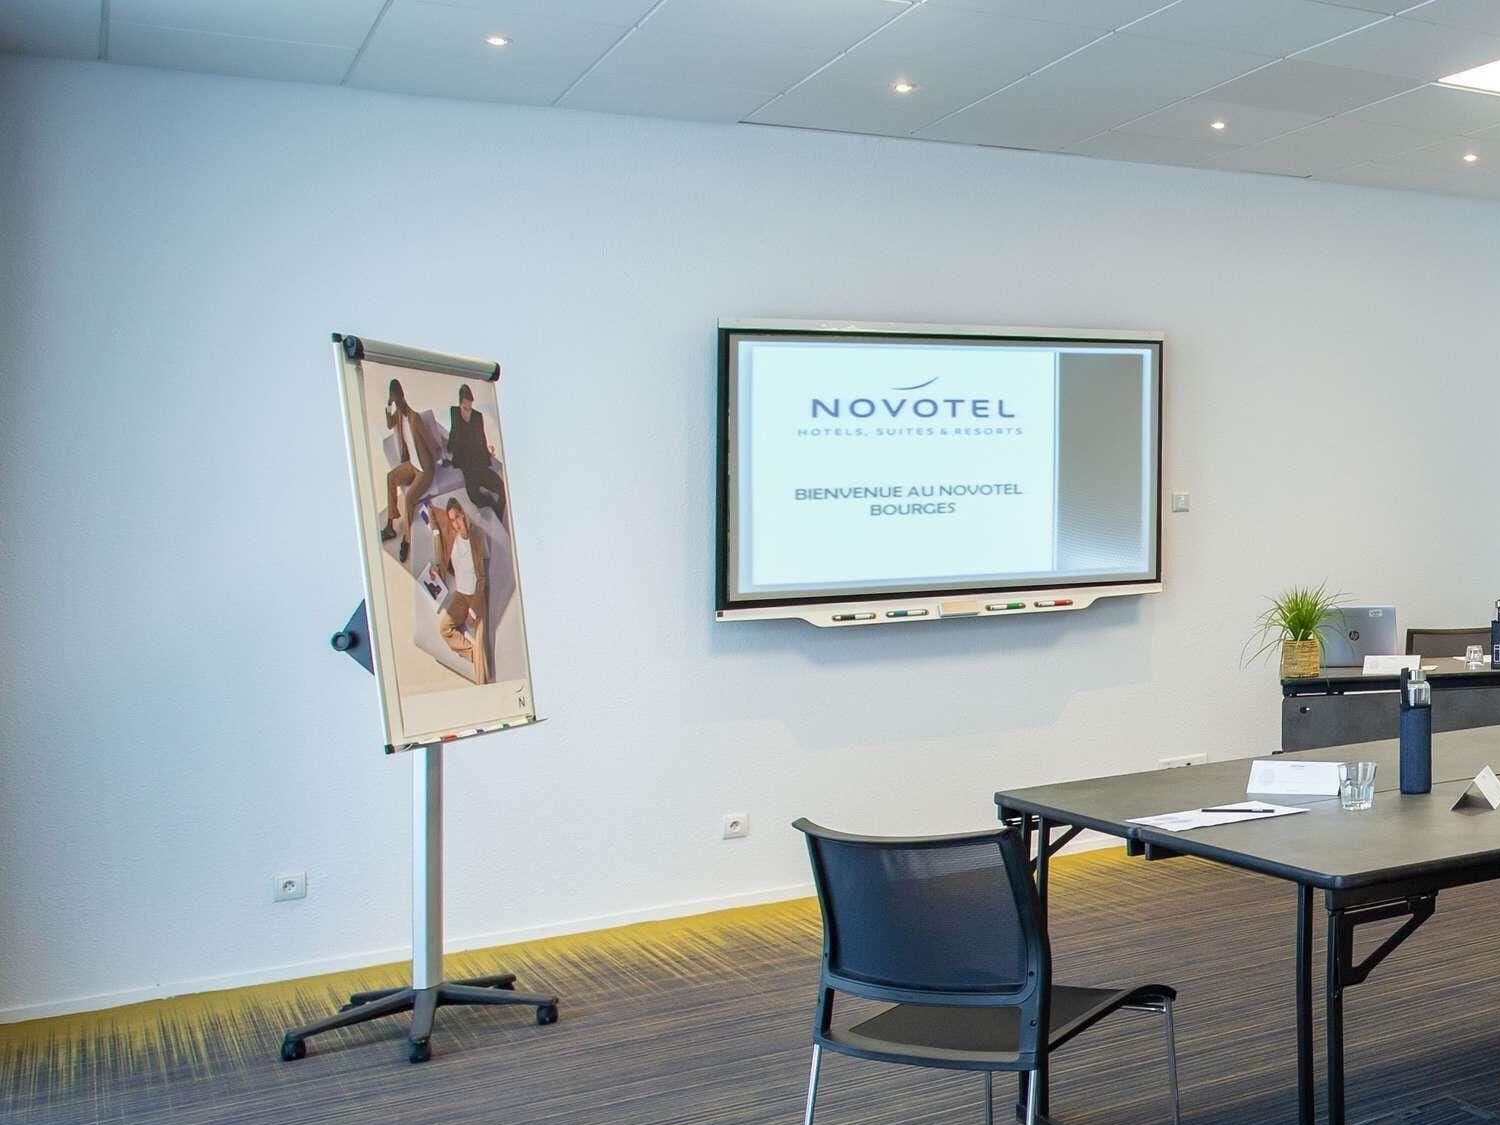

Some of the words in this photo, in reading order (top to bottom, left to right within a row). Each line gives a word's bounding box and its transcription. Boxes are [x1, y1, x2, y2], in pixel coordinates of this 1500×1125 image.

[811, 398, 1015, 418] NOVOTEL
[798, 428, 868, 437] HOTELS,
[876, 428, 934, 436] SUITES
[940, 428, 950, 436] &
[954, 427, 1023, 436] RESORTS
[795, 486, 904, 501] BIENVENUE
[907, 486, 934, 498] AU
[939, 484, 1023, 497] NOVOTEL
[870, 502, 956, 516] BOURGES
